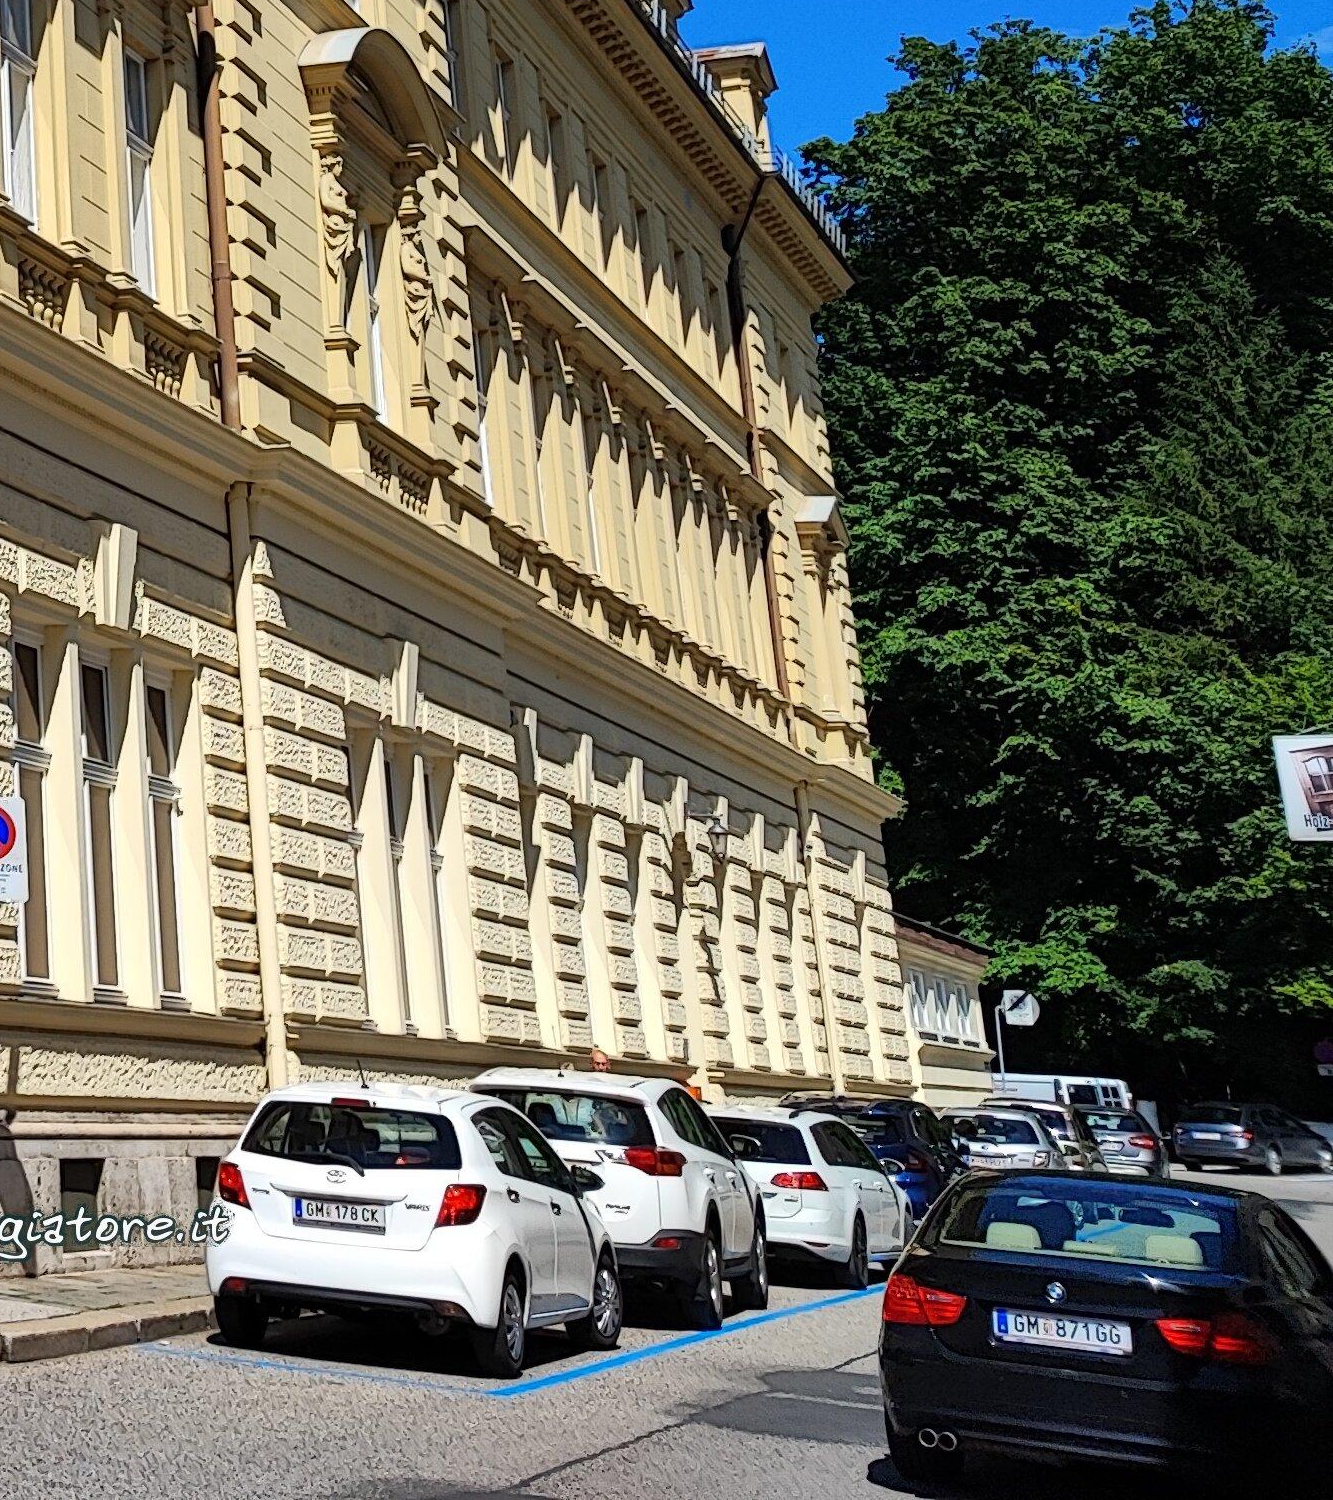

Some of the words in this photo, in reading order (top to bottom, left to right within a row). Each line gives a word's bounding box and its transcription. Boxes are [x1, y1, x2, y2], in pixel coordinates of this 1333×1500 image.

[306, 1202, 324, 1218] GM
[334, 1205, 358, 1221] 178
[362, 1207, 379, 1223] CK
[1014, 1314, 1039, 1335] GM
